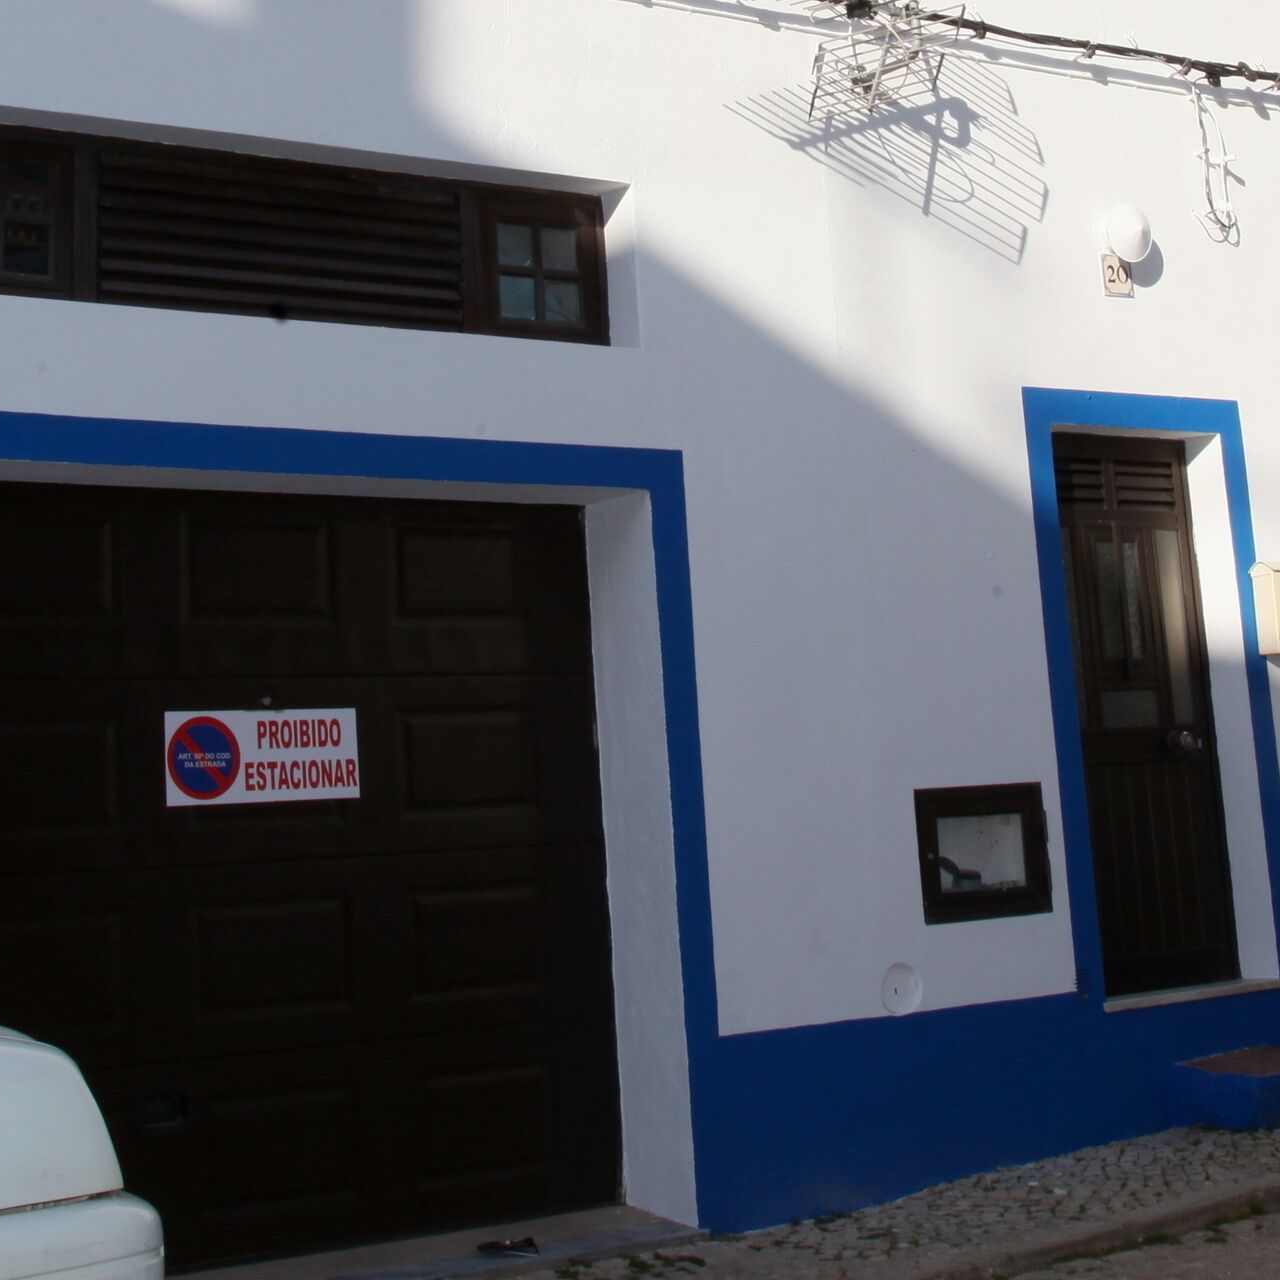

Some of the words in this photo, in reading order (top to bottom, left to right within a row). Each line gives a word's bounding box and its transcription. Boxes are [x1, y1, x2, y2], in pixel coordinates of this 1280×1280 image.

[1106, 264, 1128, 284] 20
[256, 718, 342, 750] PROIBIDO
[184, 760, 194, 768] DA
[195, 760, 226, 768] ESTRADA
[244, 758, 358, 792] ESTACIONAR
